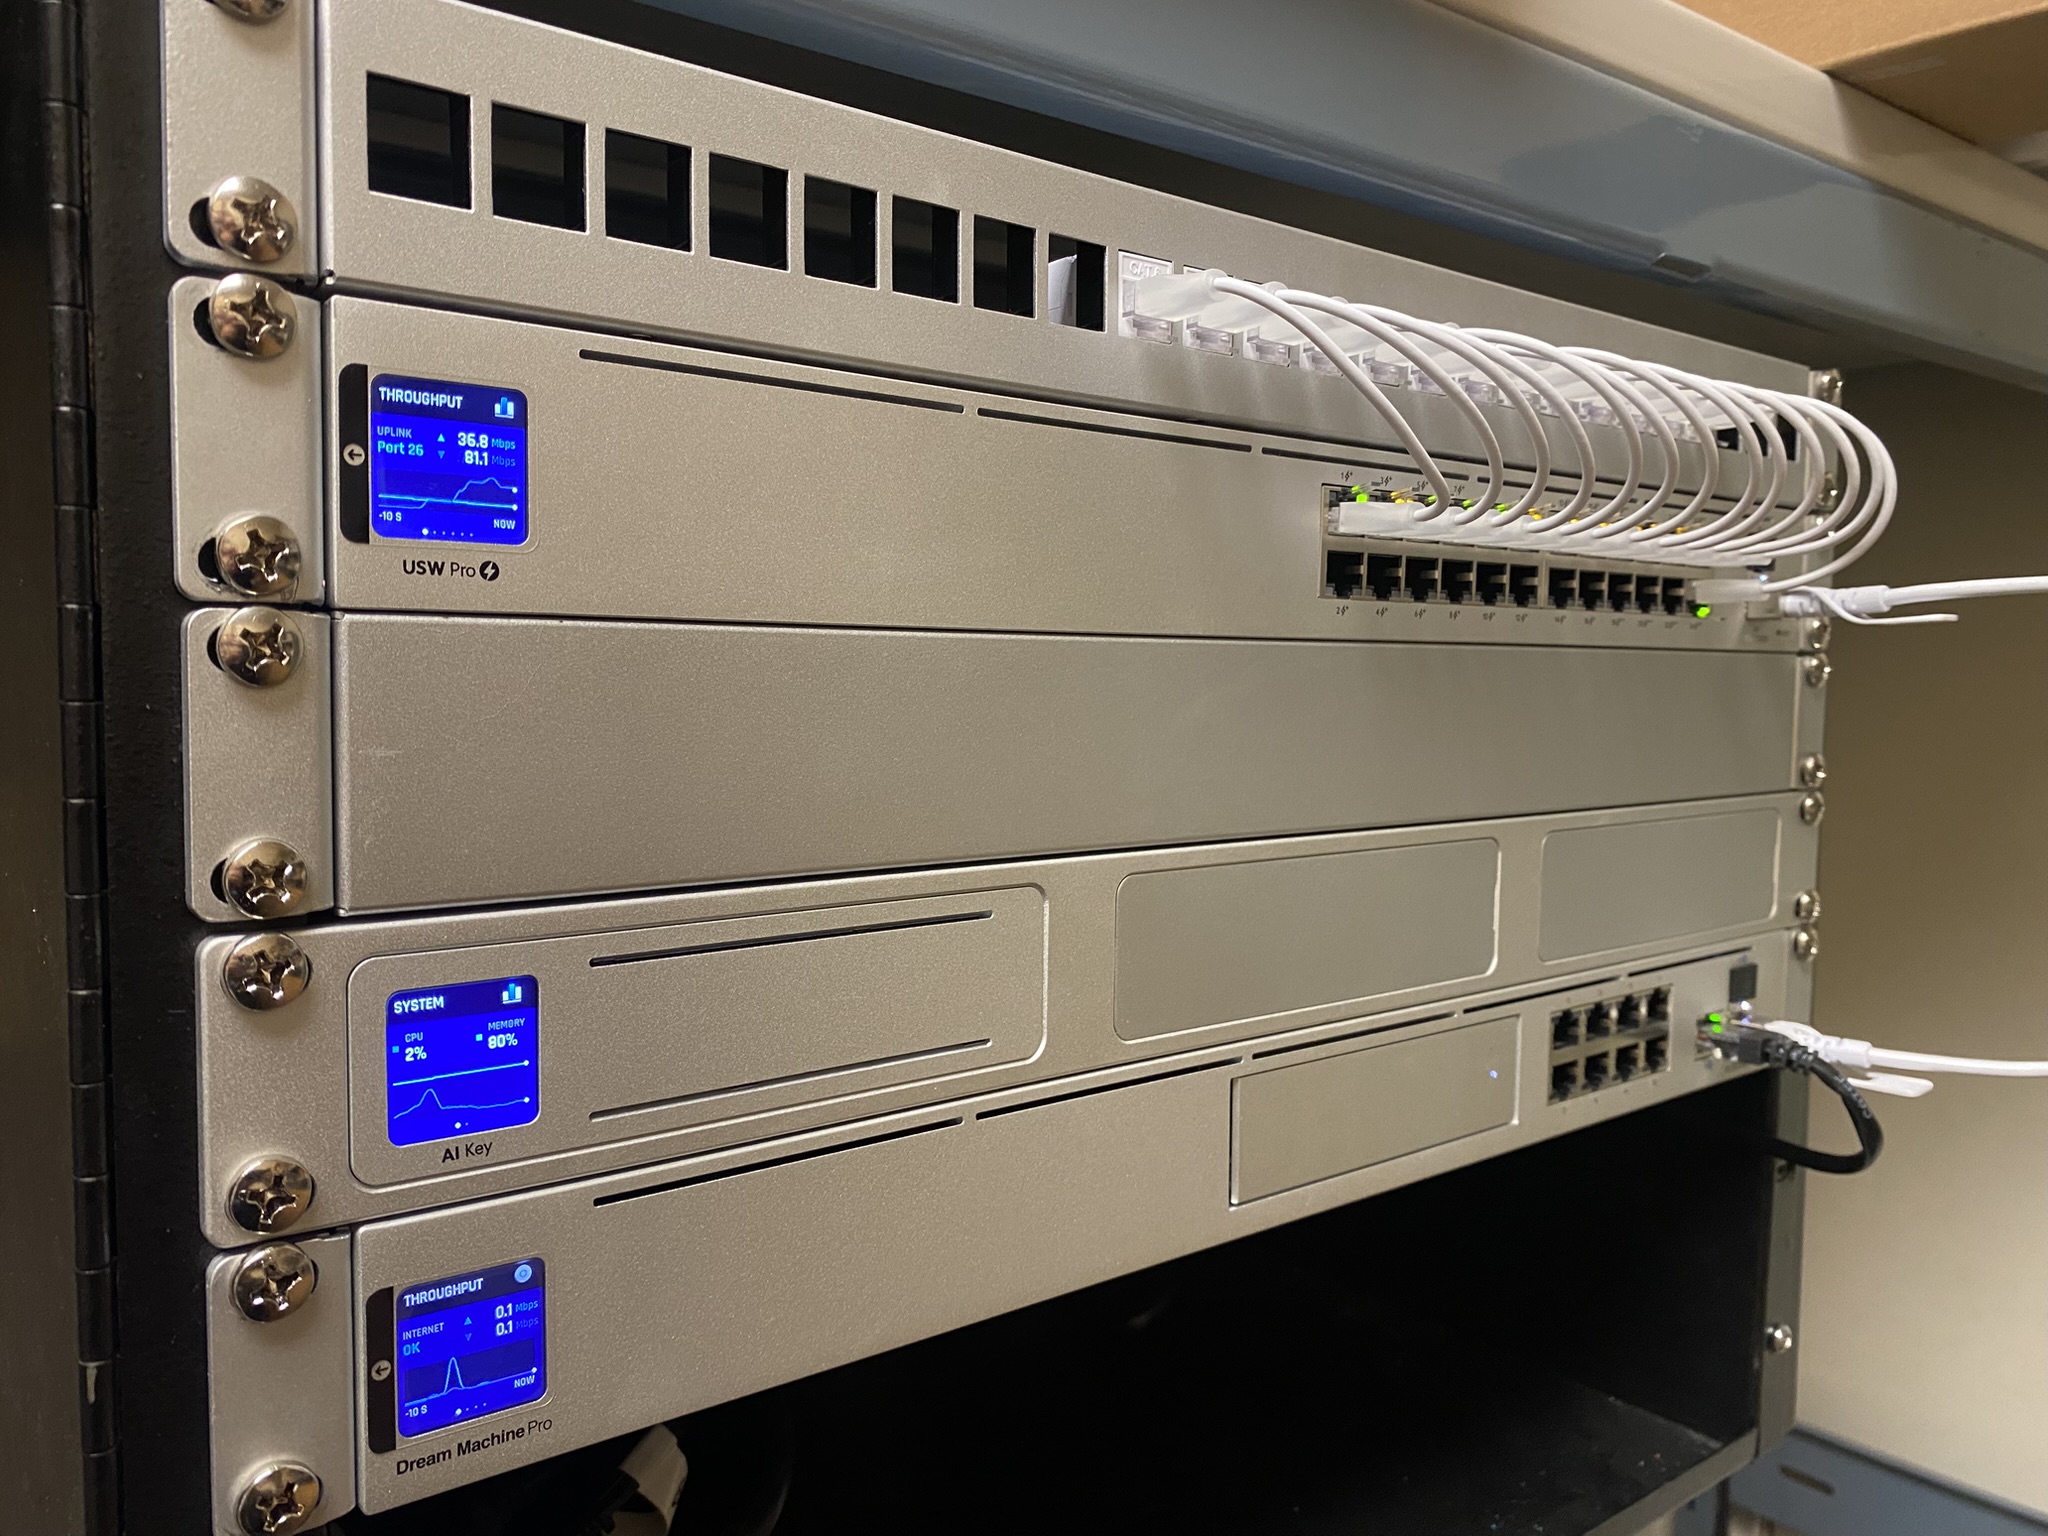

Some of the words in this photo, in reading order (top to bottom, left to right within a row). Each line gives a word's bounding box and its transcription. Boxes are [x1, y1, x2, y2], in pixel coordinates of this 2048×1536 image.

[379, 386, 463, 409] THROUGHPUT
[377, 426, 412, 439] UPLINK
[377, 441, 405, 455] Port
[408, 443, 424, 457] 26
[457, 432, 489, 449] 36.8
[491, 438, 516, 451] Mbps
[464, 450, 489, 466] 81.1
[491, 455, 516, 467] Mbps
[395, 511, 402, 521] S
[493, 519, 516, 530] NOW
[402, 559, 445, 576] USW
[450, 562, 476, 578] Pro
[393, 996, 444, 1014] SYSTEM
[488, 1018, 525, 1031] MEMORY
[405, 1032, 424, 1043] CPU
[488, 1033, 518, 1049] 80%
[405, 1046, 427, 1062] 2%
[442, 1146, 459, 1163] AI
[465, 1142, 493, 1157] Key
[403, 1278, 484, 1307] THROUGHPUT
[495, 1303, 513, 1319] 0.1
[515, 1300, 538, 1313] Mbps
[402, 1322, 444, 1340] INTERNET
[496, 1320, 513, 1337] 0.1
[516, 1317, 539, 1330] Mbps
[403, 1342, 420, 1356] OK
[514, 1375, 535, 1388] NOW
[421, 1405, 428, 1414] S
[396, 1450, 452, 1475] Dream
[457, 1428, 525, 1457] Machine
[528, 1419, 553, 1436] Pro
